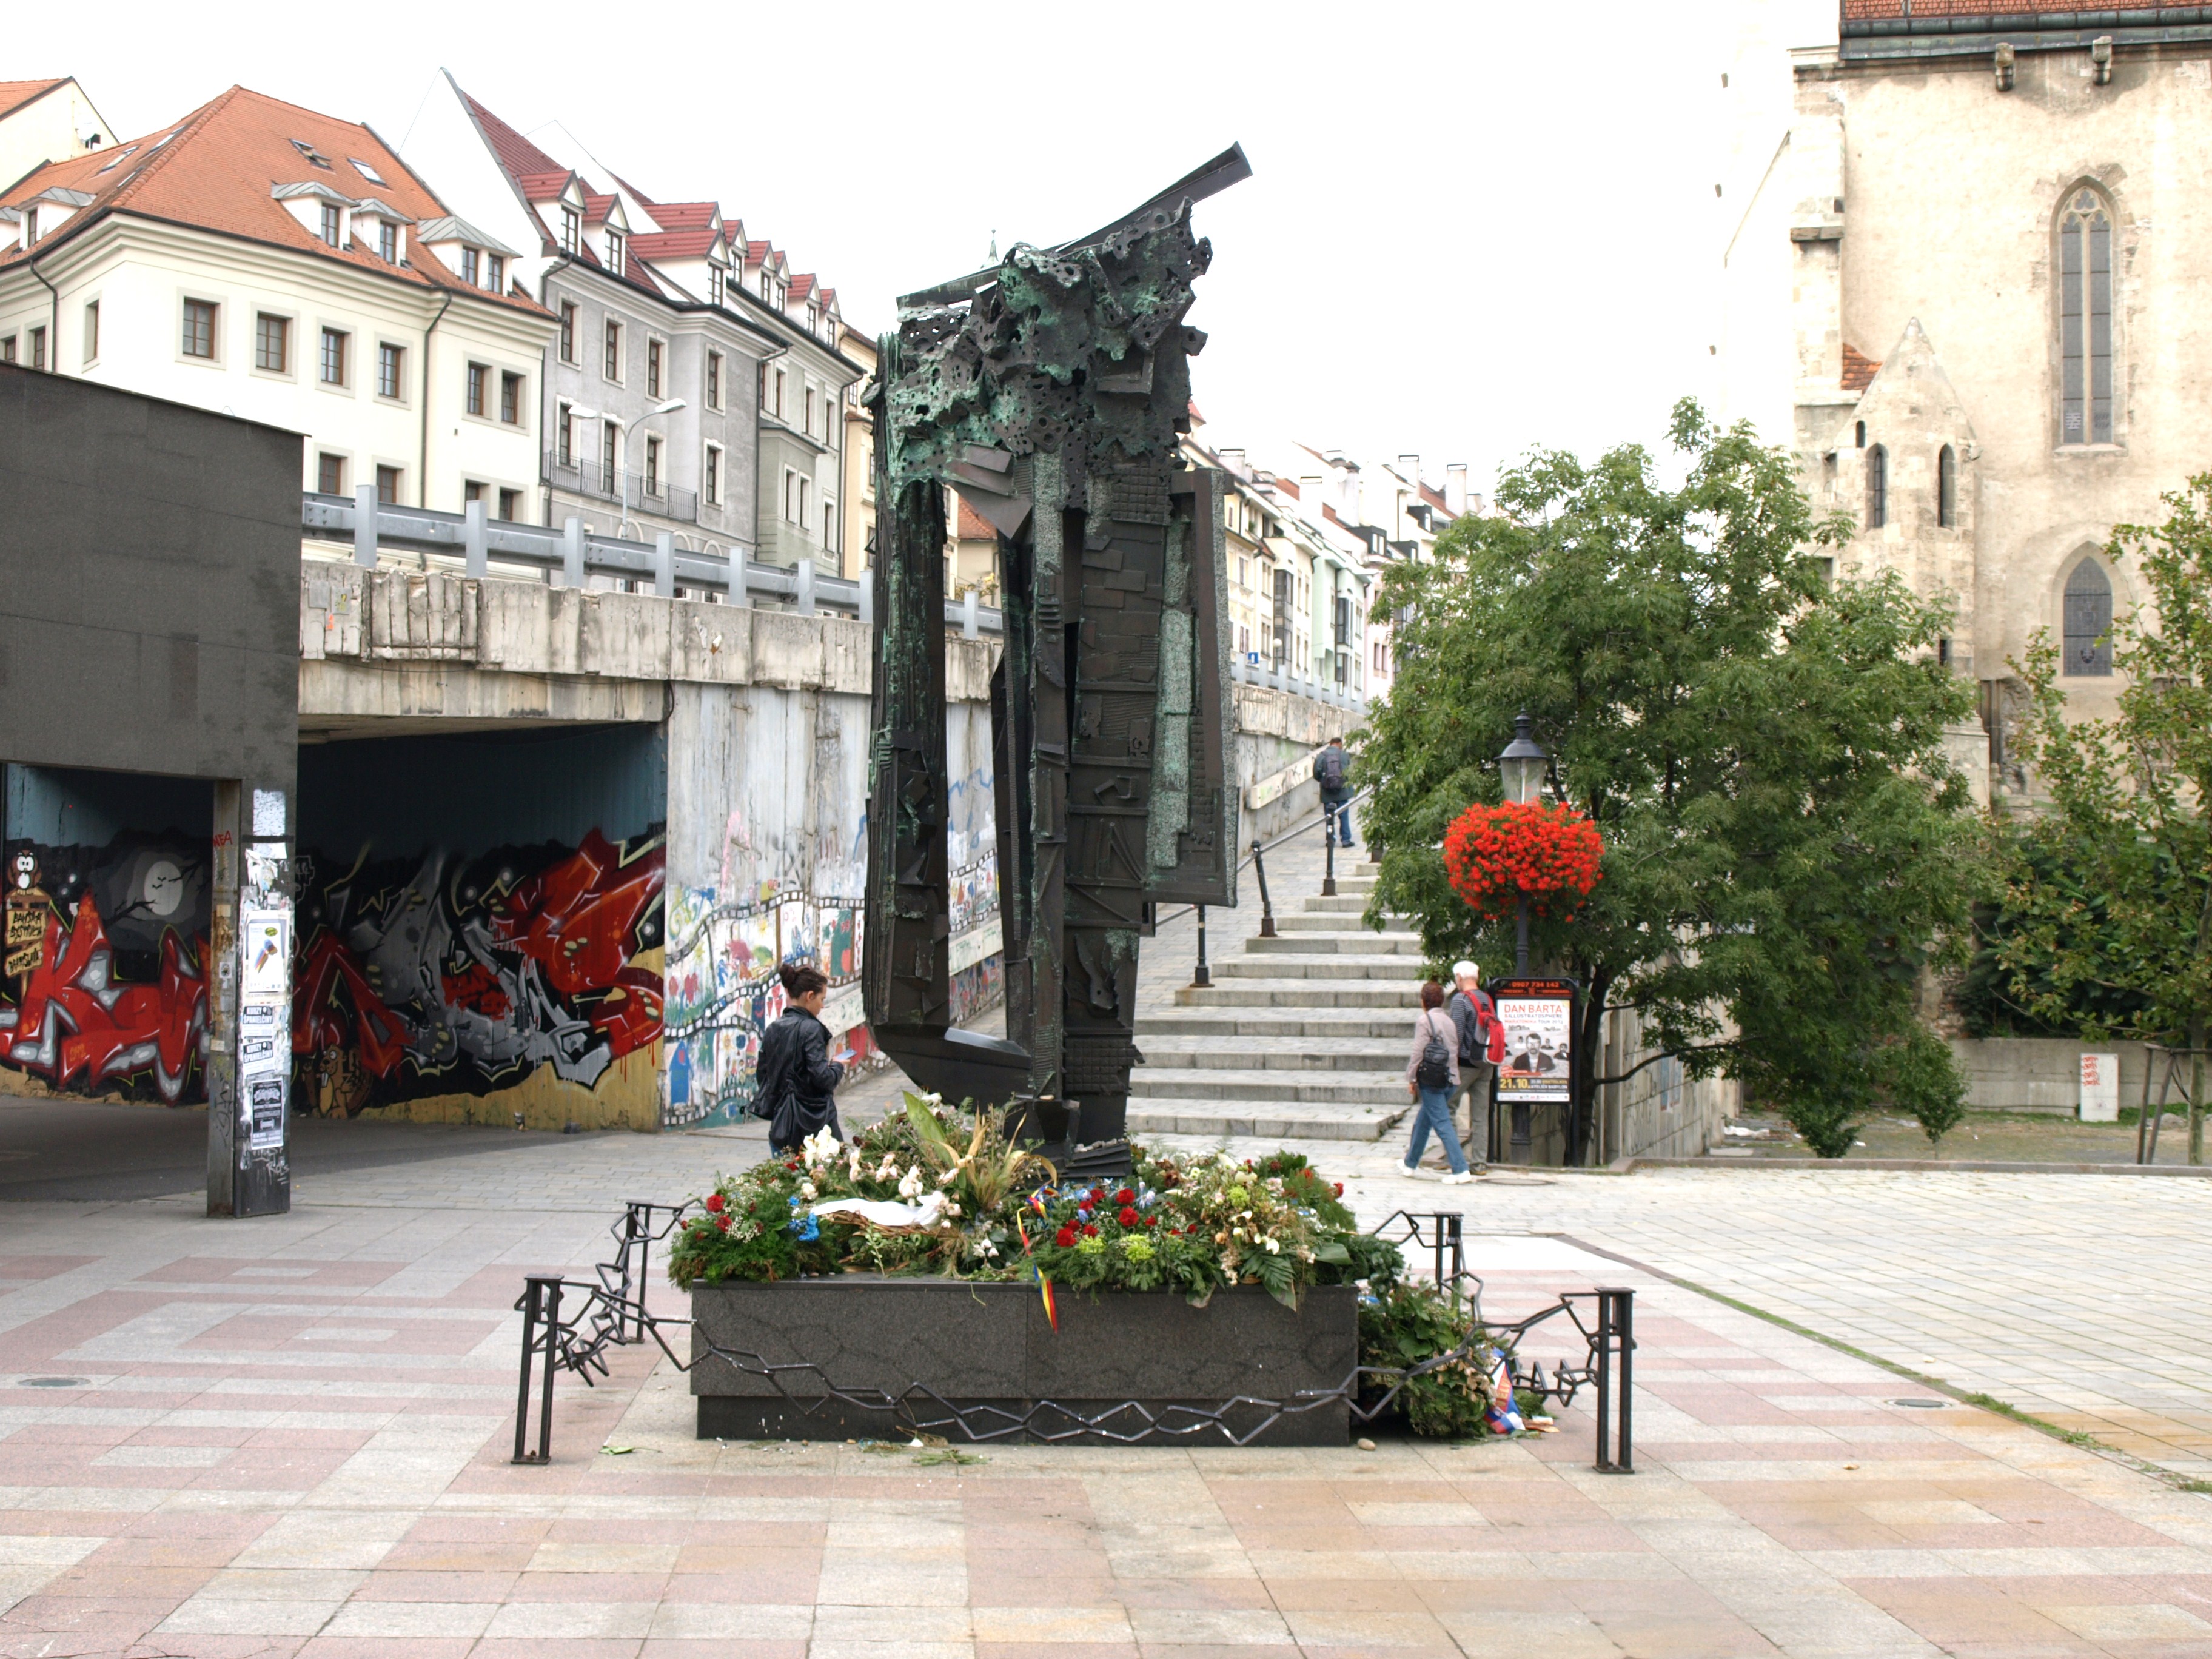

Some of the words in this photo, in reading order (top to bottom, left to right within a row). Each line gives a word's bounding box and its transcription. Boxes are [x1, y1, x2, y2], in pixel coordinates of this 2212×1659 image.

[246, 1007, 262, 1015] KURZY
[1504, 1005, 1526, 1013] DAN
[1528, 1002, 1563, 1013] BÁRTA
[246, 1043, 262, 1053] KURZY
[1500, 1078, 1531, 1089] 21.10.
